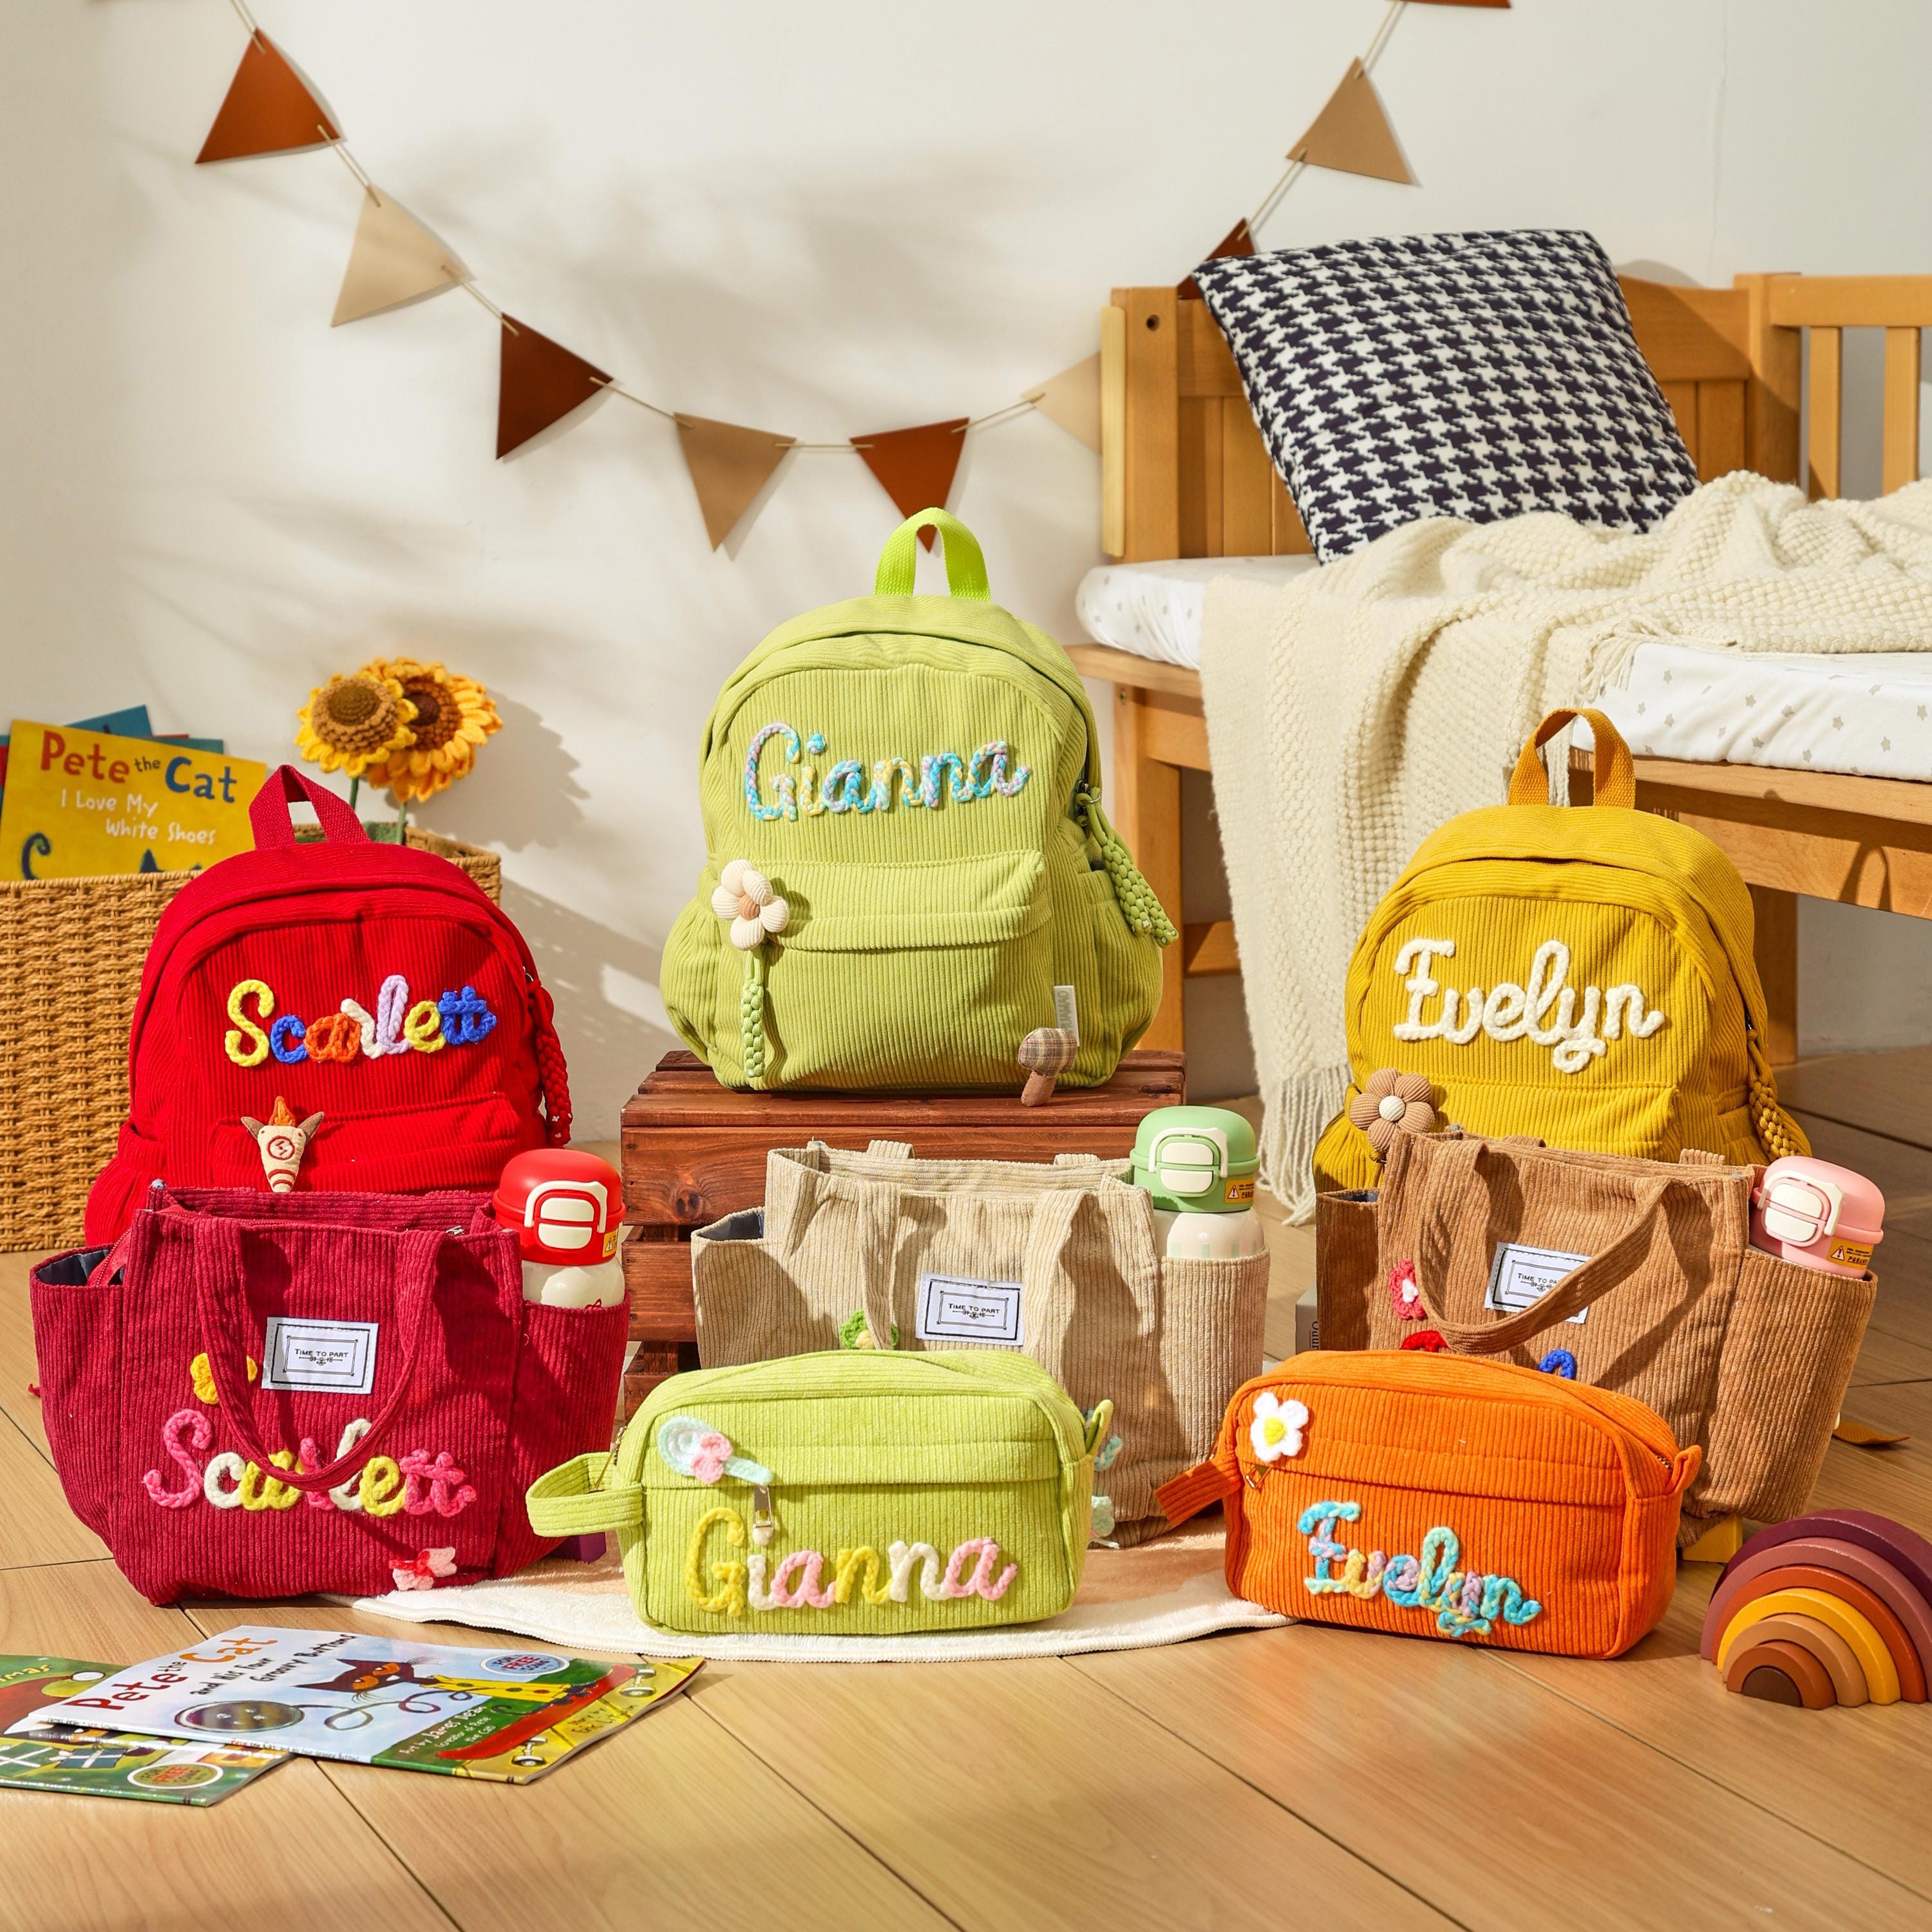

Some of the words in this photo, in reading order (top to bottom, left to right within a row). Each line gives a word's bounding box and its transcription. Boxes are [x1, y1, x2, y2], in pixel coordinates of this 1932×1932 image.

[40, 730, 129, 784] Pete
[134, 757, 161, 773] the
[165, 757, 236, 804] Cat
[744, 721, 1030, 822] Gianna
[61, 789, 67, 808] I
[76, 790, 117, 812] Love
[127, 793, 158, 818] My
[106, 817, 158, 840] White
[168, 821, 216, 846] Shoes
[225, 974, 497, 1067] Scarlett
[1393, 937, 1666, 1074] Evelyn
[1517, 1273, 1535, 1281] TIME
[685, 1506, 1018, 1617] Gianna
[1297, 1501, 1542, 1637] Evelyn
[62, 1673, 189, 1710] Pete
[156, 1661, 187, 1672] the
[179, 1638, 278, 1663] Cat
[189, 1681, 225, 1695] and
[210, 1670, 246, 1680] His
[249, 1658, 309, 1681] Groovy
[294, 1634, 357, 1658] Buttons
[501, 1655, 540, 1670] FREE
[422, 1720, 460, 1739] James
